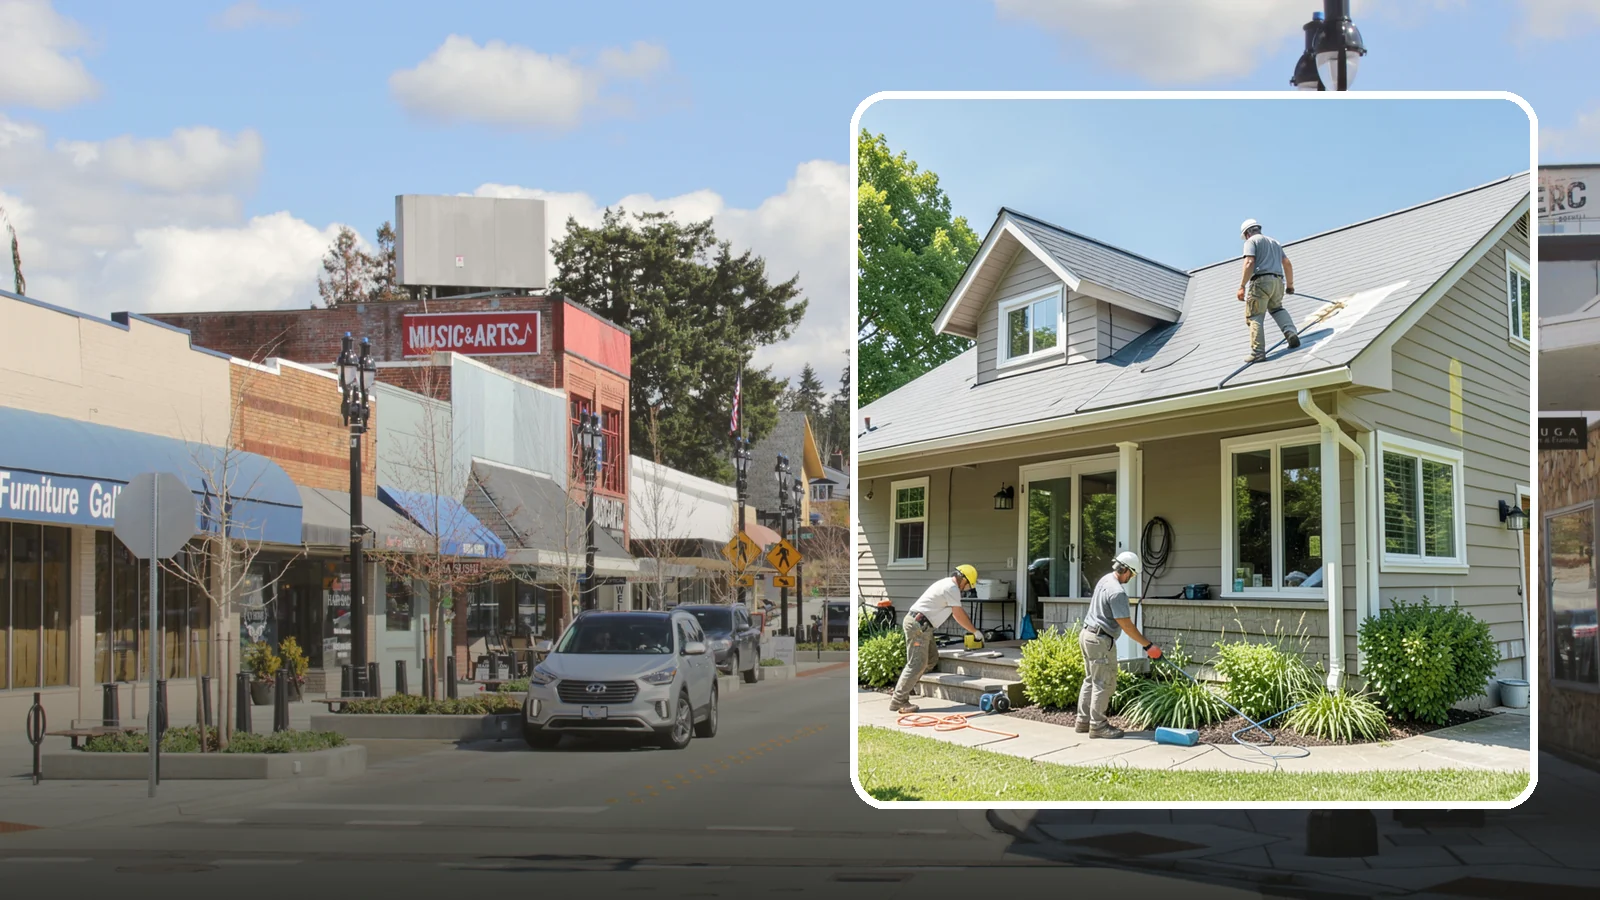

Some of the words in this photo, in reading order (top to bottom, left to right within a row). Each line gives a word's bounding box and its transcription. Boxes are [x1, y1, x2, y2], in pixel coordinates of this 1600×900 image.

[408, 323, 520, 348] MUSIC&ARTS
[0, 471, 79, 515] Furniture
[89, 482, 122, 518] Gal
